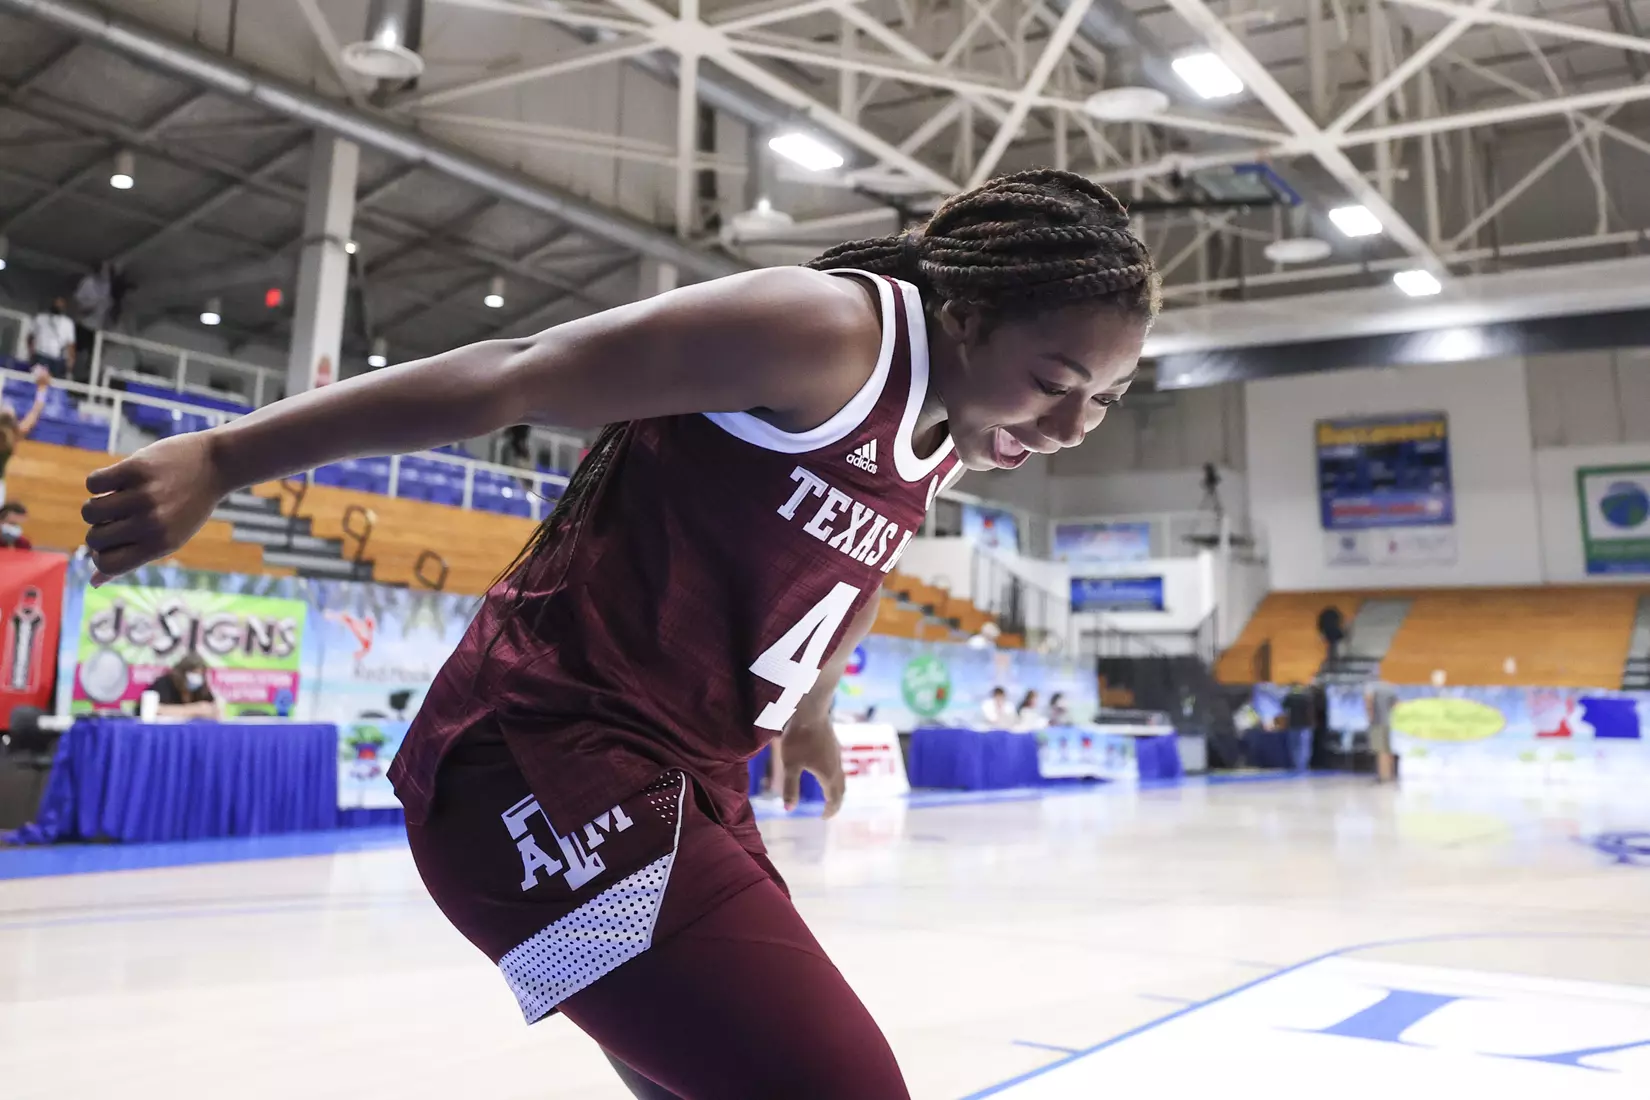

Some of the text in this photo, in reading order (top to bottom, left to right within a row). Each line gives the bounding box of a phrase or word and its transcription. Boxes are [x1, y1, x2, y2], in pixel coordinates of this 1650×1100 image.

[846, 453, 878, 475] adidas
[777, 465, 899, 567] TEXAS
[750, 581, 861, 732] 4
